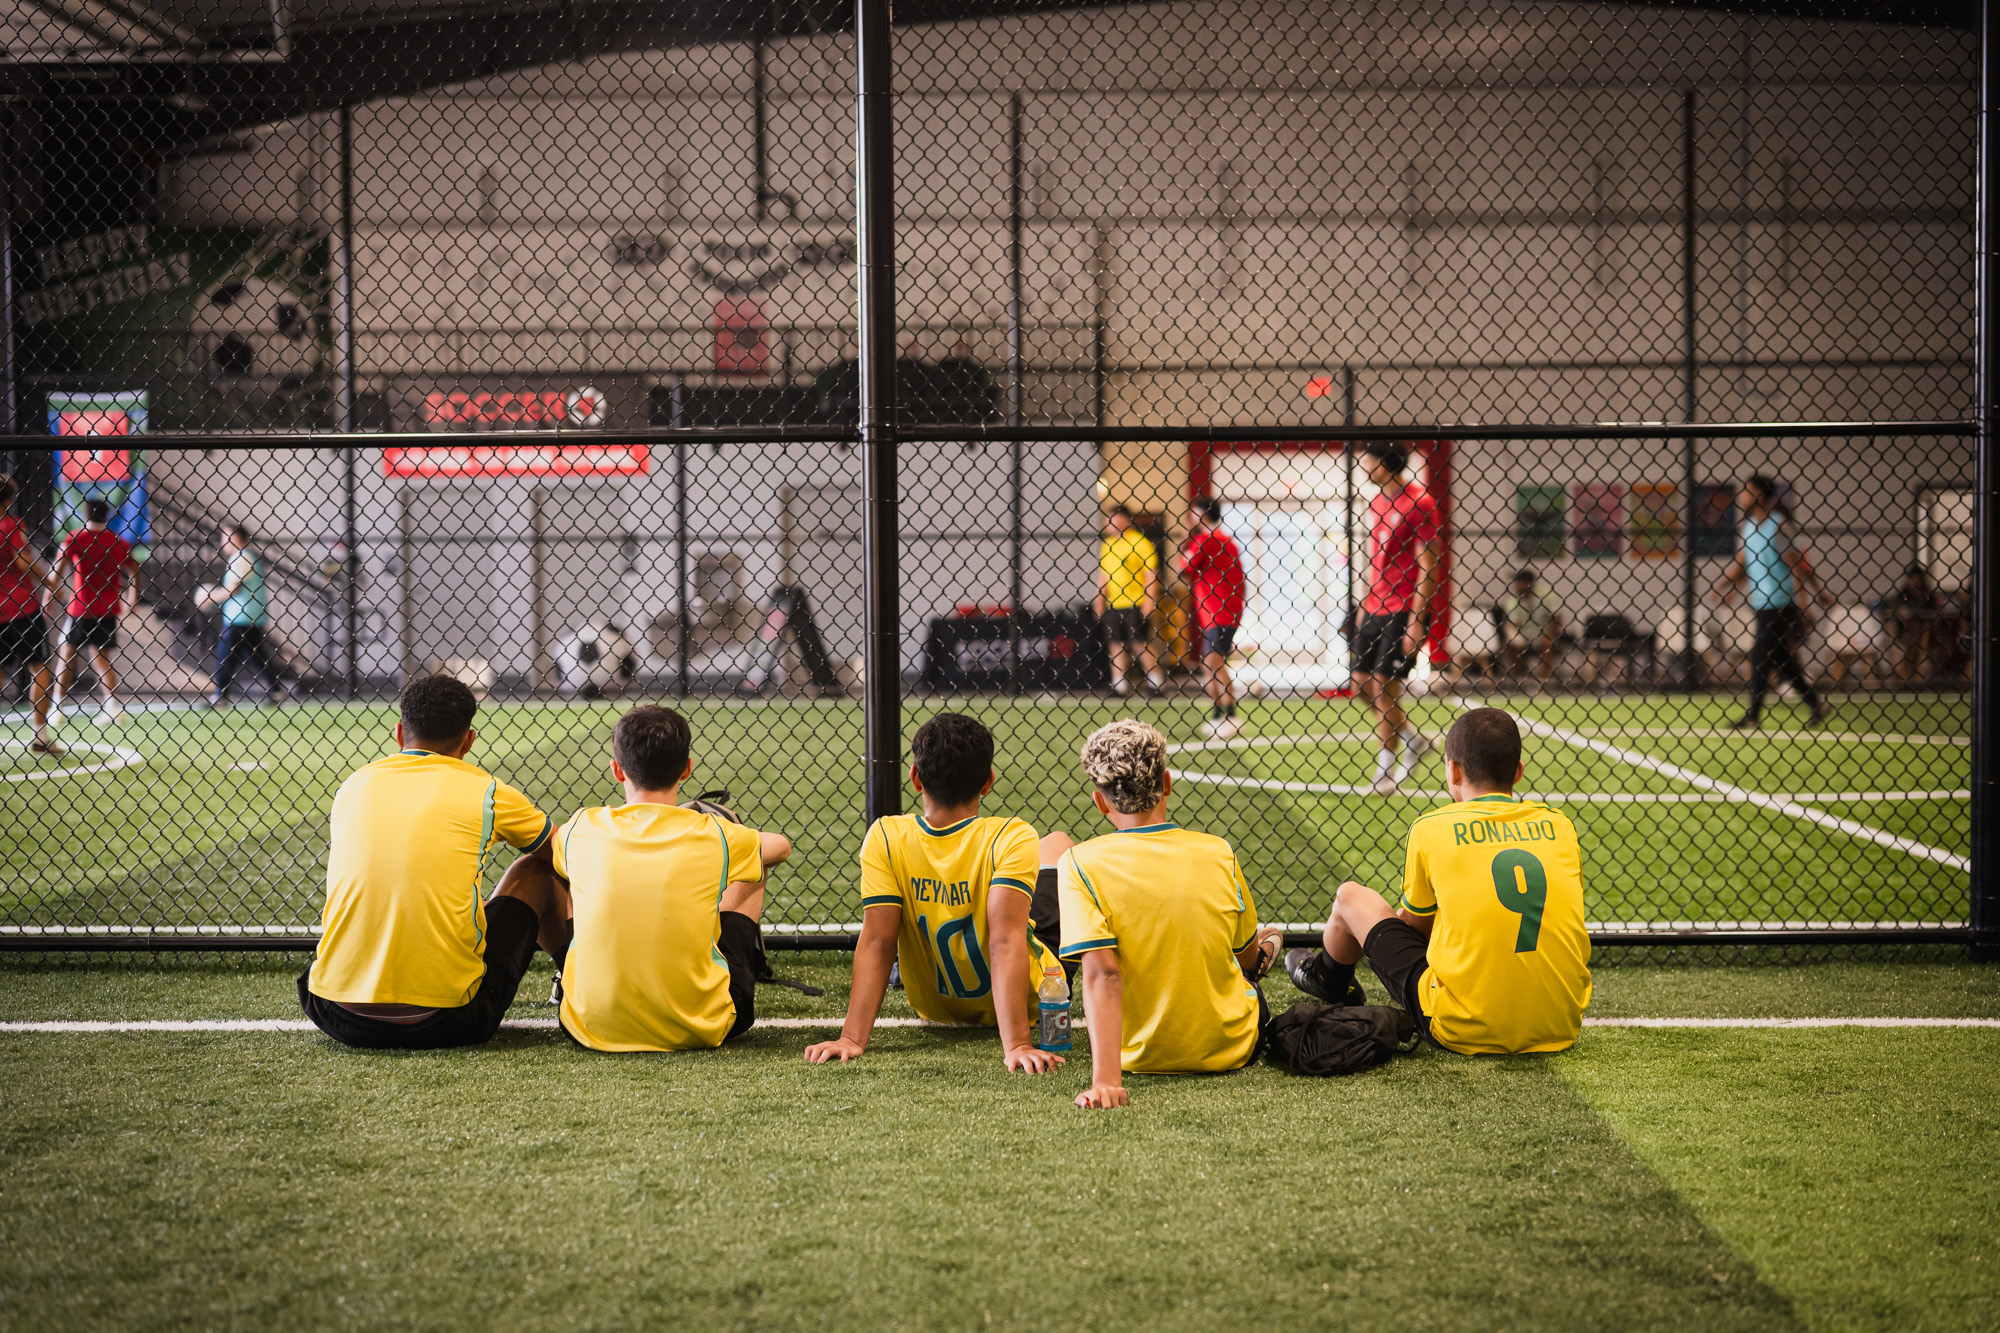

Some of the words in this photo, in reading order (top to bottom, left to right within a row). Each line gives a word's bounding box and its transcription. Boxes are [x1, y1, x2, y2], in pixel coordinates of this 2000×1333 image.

[425, 391, 568, 424] SOCCER
[1453, 820, 1556, 846] RONALDO
[911, 876, 972, 907] NEYMAR
[1491, 848, 1548, 954] 9
[917, 912, 992, 999] 10
